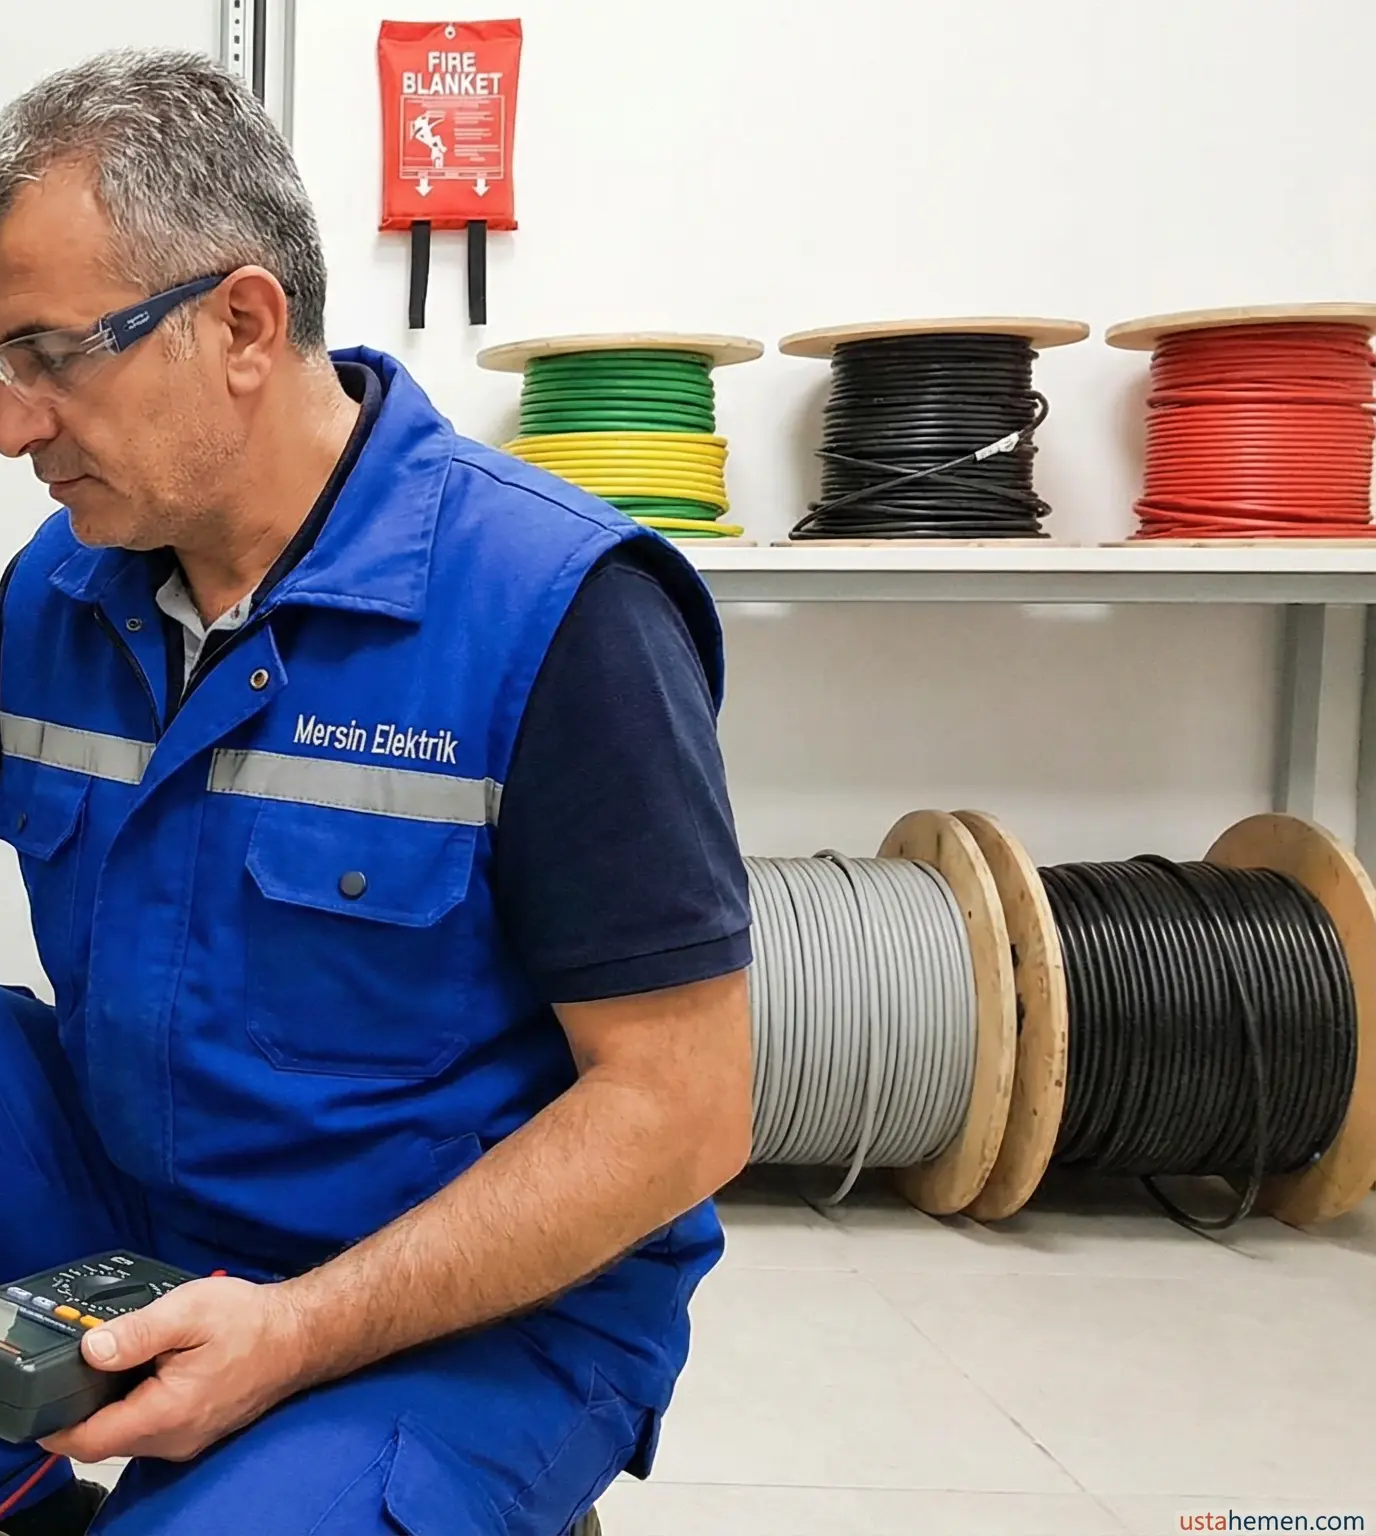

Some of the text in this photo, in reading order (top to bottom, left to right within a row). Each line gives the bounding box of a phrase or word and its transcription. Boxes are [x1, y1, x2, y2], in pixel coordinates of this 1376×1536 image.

[428, 51, 477, 74] FIRE
[403, 72, 502, 95] BLANKET
[293, 714, 459, 765] Mersin Elektrik
